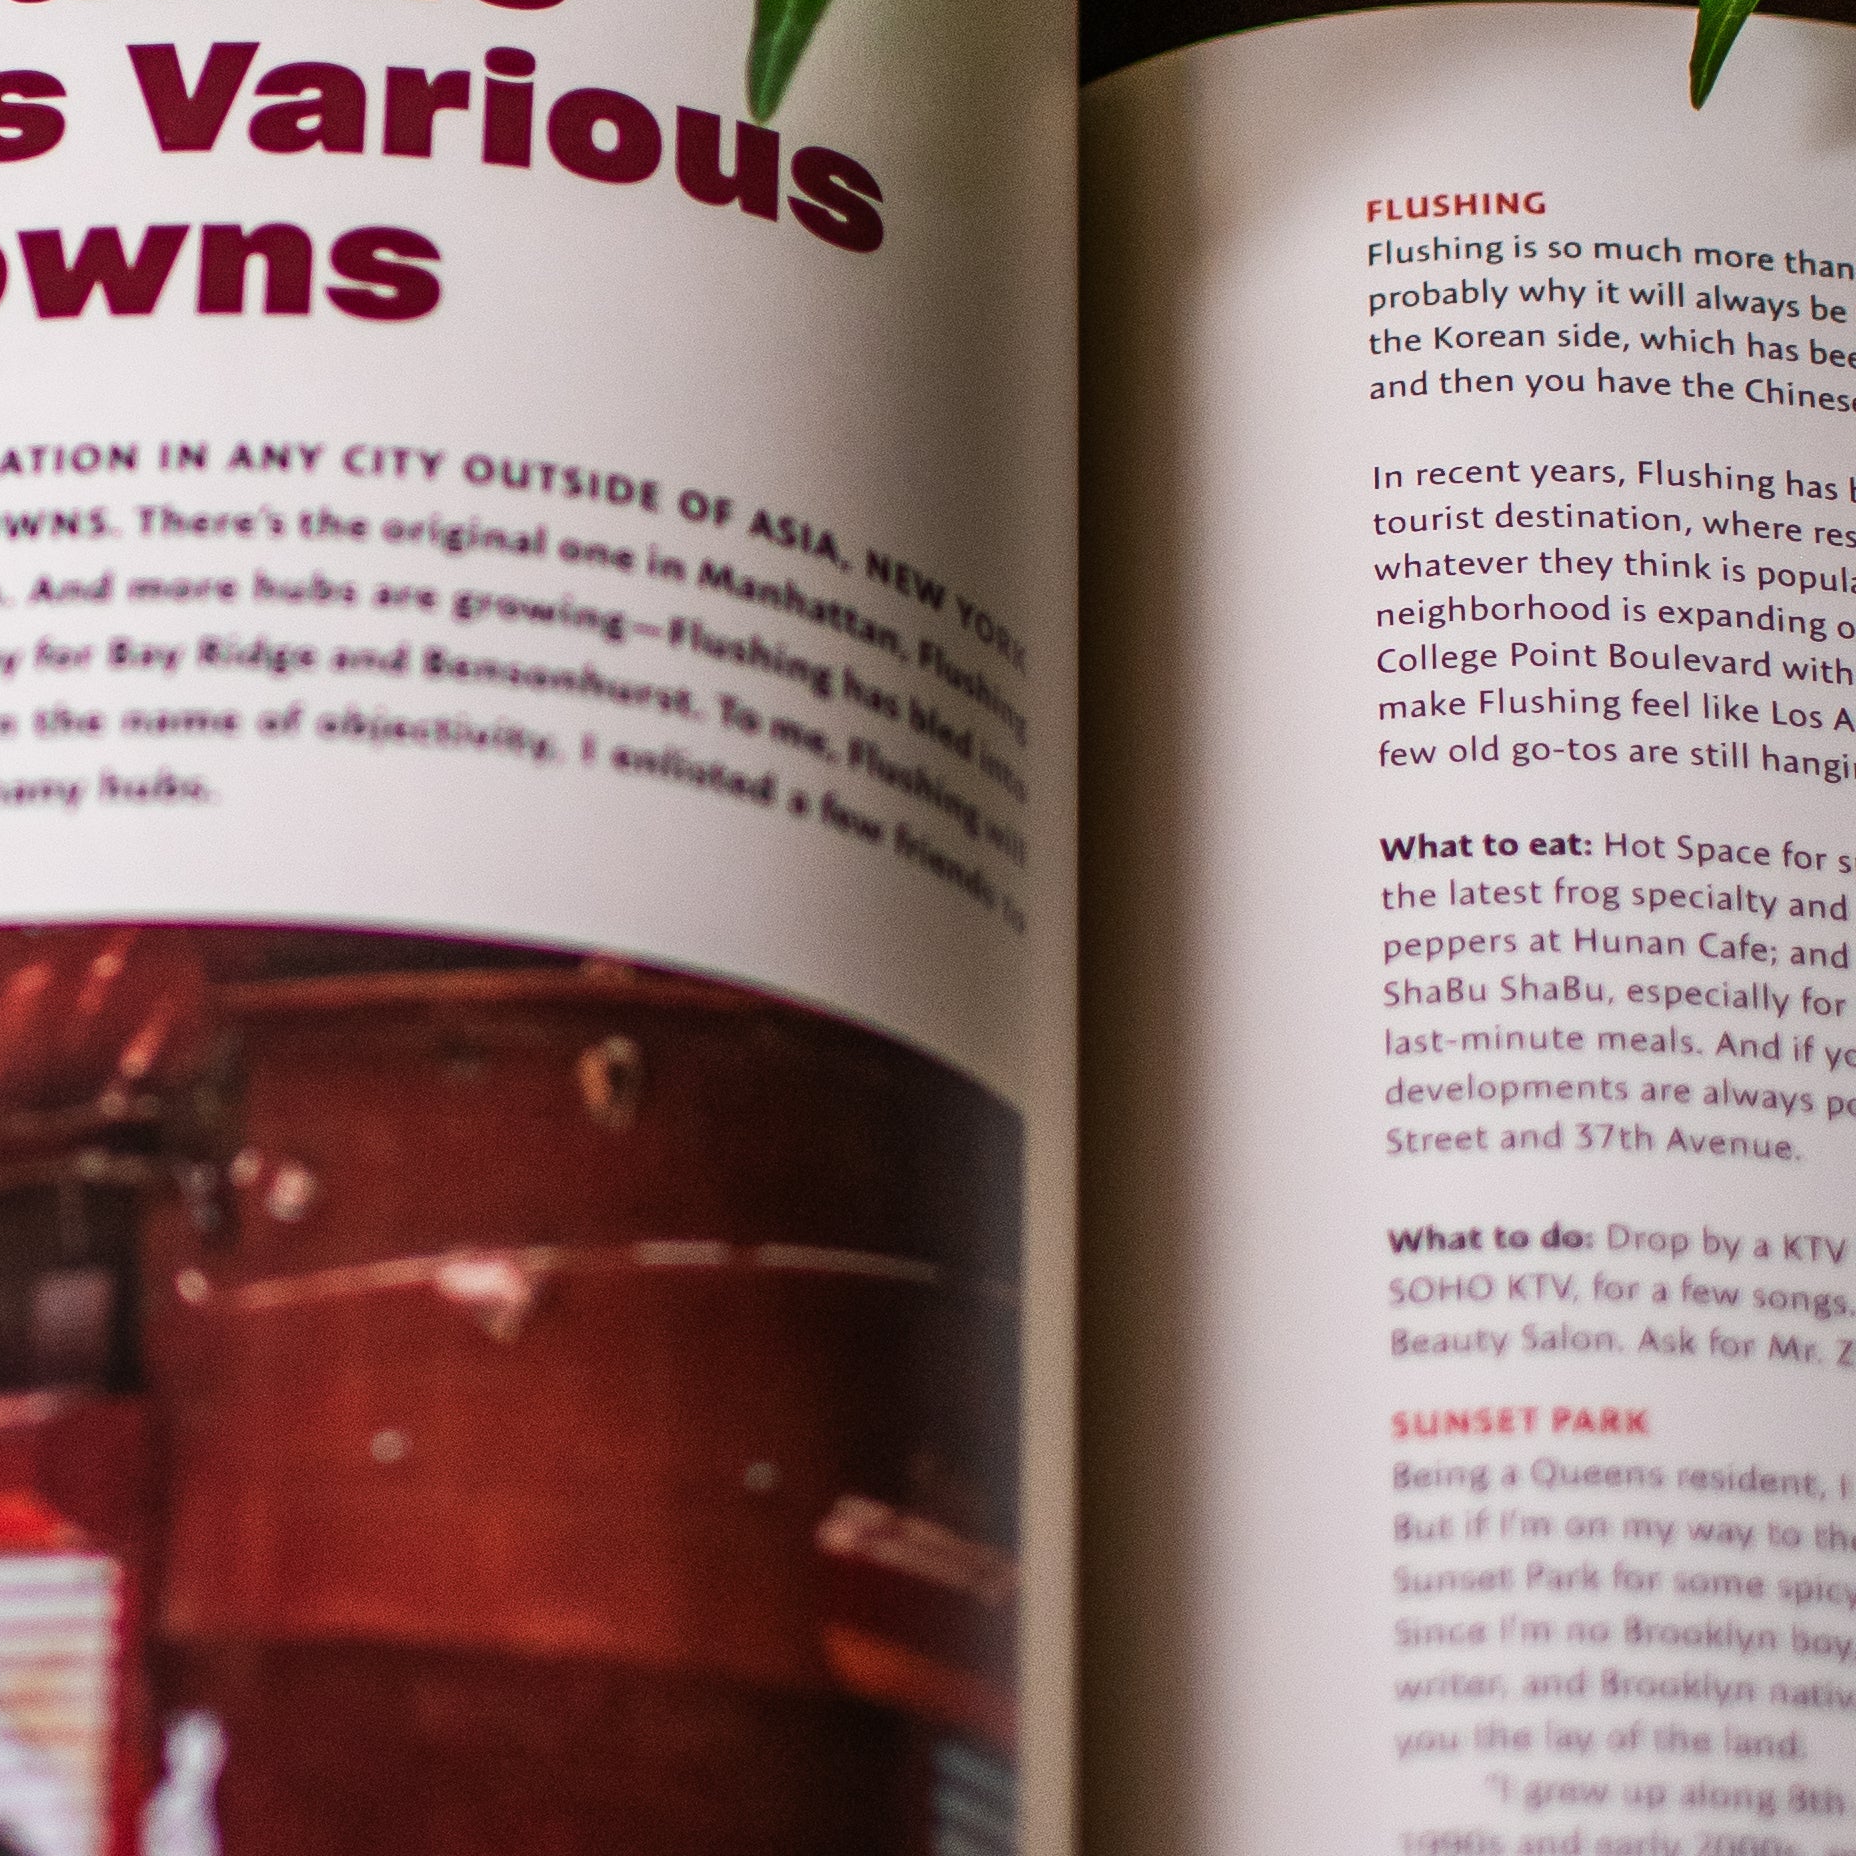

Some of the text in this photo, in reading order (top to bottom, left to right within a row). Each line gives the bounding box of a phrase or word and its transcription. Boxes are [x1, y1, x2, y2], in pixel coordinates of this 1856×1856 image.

[126, 41, 885, 254] Various
[1366, 191, 1547, 223] FLUSHING
[1367, 236, 1856, 281] Flushing is so much more than
[1368, 277, 1847, 325] probably why it will always be
[1368, 329, 1422, 356] the
[1433, 326, 1546, 350] Korean
[1639, 325, 1736, 356] which
[1746, 332, 1800, 363] has
[1369, 367, 1856, 414] and then you have the Chines
[1373, 466, 1403, 490] In
[1416, 460, 1520, 486] recent
[1530, 464, 1625, 489] years,
[1637, 459, 1776, 501] Flushing
[1785, 469, 1839, 502] has
[160, 442, 208, 472] IN
[229, 442, 324, 474] ANY
[342, 445, 443, 479] CITY
[463, 454, 660, 513] OUTSIDE
[678, 489, 733, 528] OF
[864, 548, 946, 611] NEW
[1373, 507, 1483, 536] tourist
[1494, 502, 1692, 536] destination,
[1702, 510, 1803, 543] where
[299, 507, 369, 542] the
[382, 511, 548, 556] original
[558, 538, 635, 573] one
[647, 544, 688, 582] in
[1373, 552, 1528, 582] whatever
[1538, 547, 1614, 581] they
[1623, 549, 1711, 580] think
[1722, 556, 1747, 583] is
[1376, 593, 1611, 630] neighborhood
[1622, 603, 1647, 623] is
[1657, 604, 1828, 644] expanding
[1376, 641, 1855, 686] College Point Boulevard with
[1378, 690, 1466, 720] make
[1479, 687, 1622, 722] Flushing
[1631, 688, 1690, 718] feel
[1702, 693, 1760, 724] like
[1771, 700, 1824, 730] Los
[1378, 734, 1856, 785] few old go-tos are still hangi
[1379, 833, 1826, 870] What to eat: Hot Space for
[1381, 876, 1850, 923] the latest frog specialty and
[1383, 934, 1518, 965] peppers
[1529, 930, 1560, 953] at
[1573, 928, 1686, 956] Hunan
[1789, 941, 1851, 971] and
[1383, 974, 1847, 1019] ShaBu ShaBu, especially for
[1385, 1024, 1585, 1058] last-minute
[1597, 1025, 1704, 1056] meals.
[1715, 1030, 1781, 1062] And
[1793, 1033, 1815, 1064] if
[1385, 1074, 1815, 1117] developments are always
[1387, 1123, 1803, 1161] Street and 37th Avenue.
[1388, 1225, 1482, 1255] What
[1493, 1227, 1531, 1250] to
[1608, 1226, 1689, 1257] Drop
[1703, 1230, 1740, 1260] by
[1755, 1240, 1770, 1258] a
[1783, 1235, 1846, 1265] KTV
[1389, 1275, 1495, 1305] SOHO
[1592, 1273, 1639, 1302] for
[1652, 1283, 1670, 1304] a
[1680, 1275, 1741, 1307] few
[1390, 1320, 1822, 1364] Beauty Salon. Ask for Mr.
[1393, 1407, 1647, 1438] SUNSET PARK
